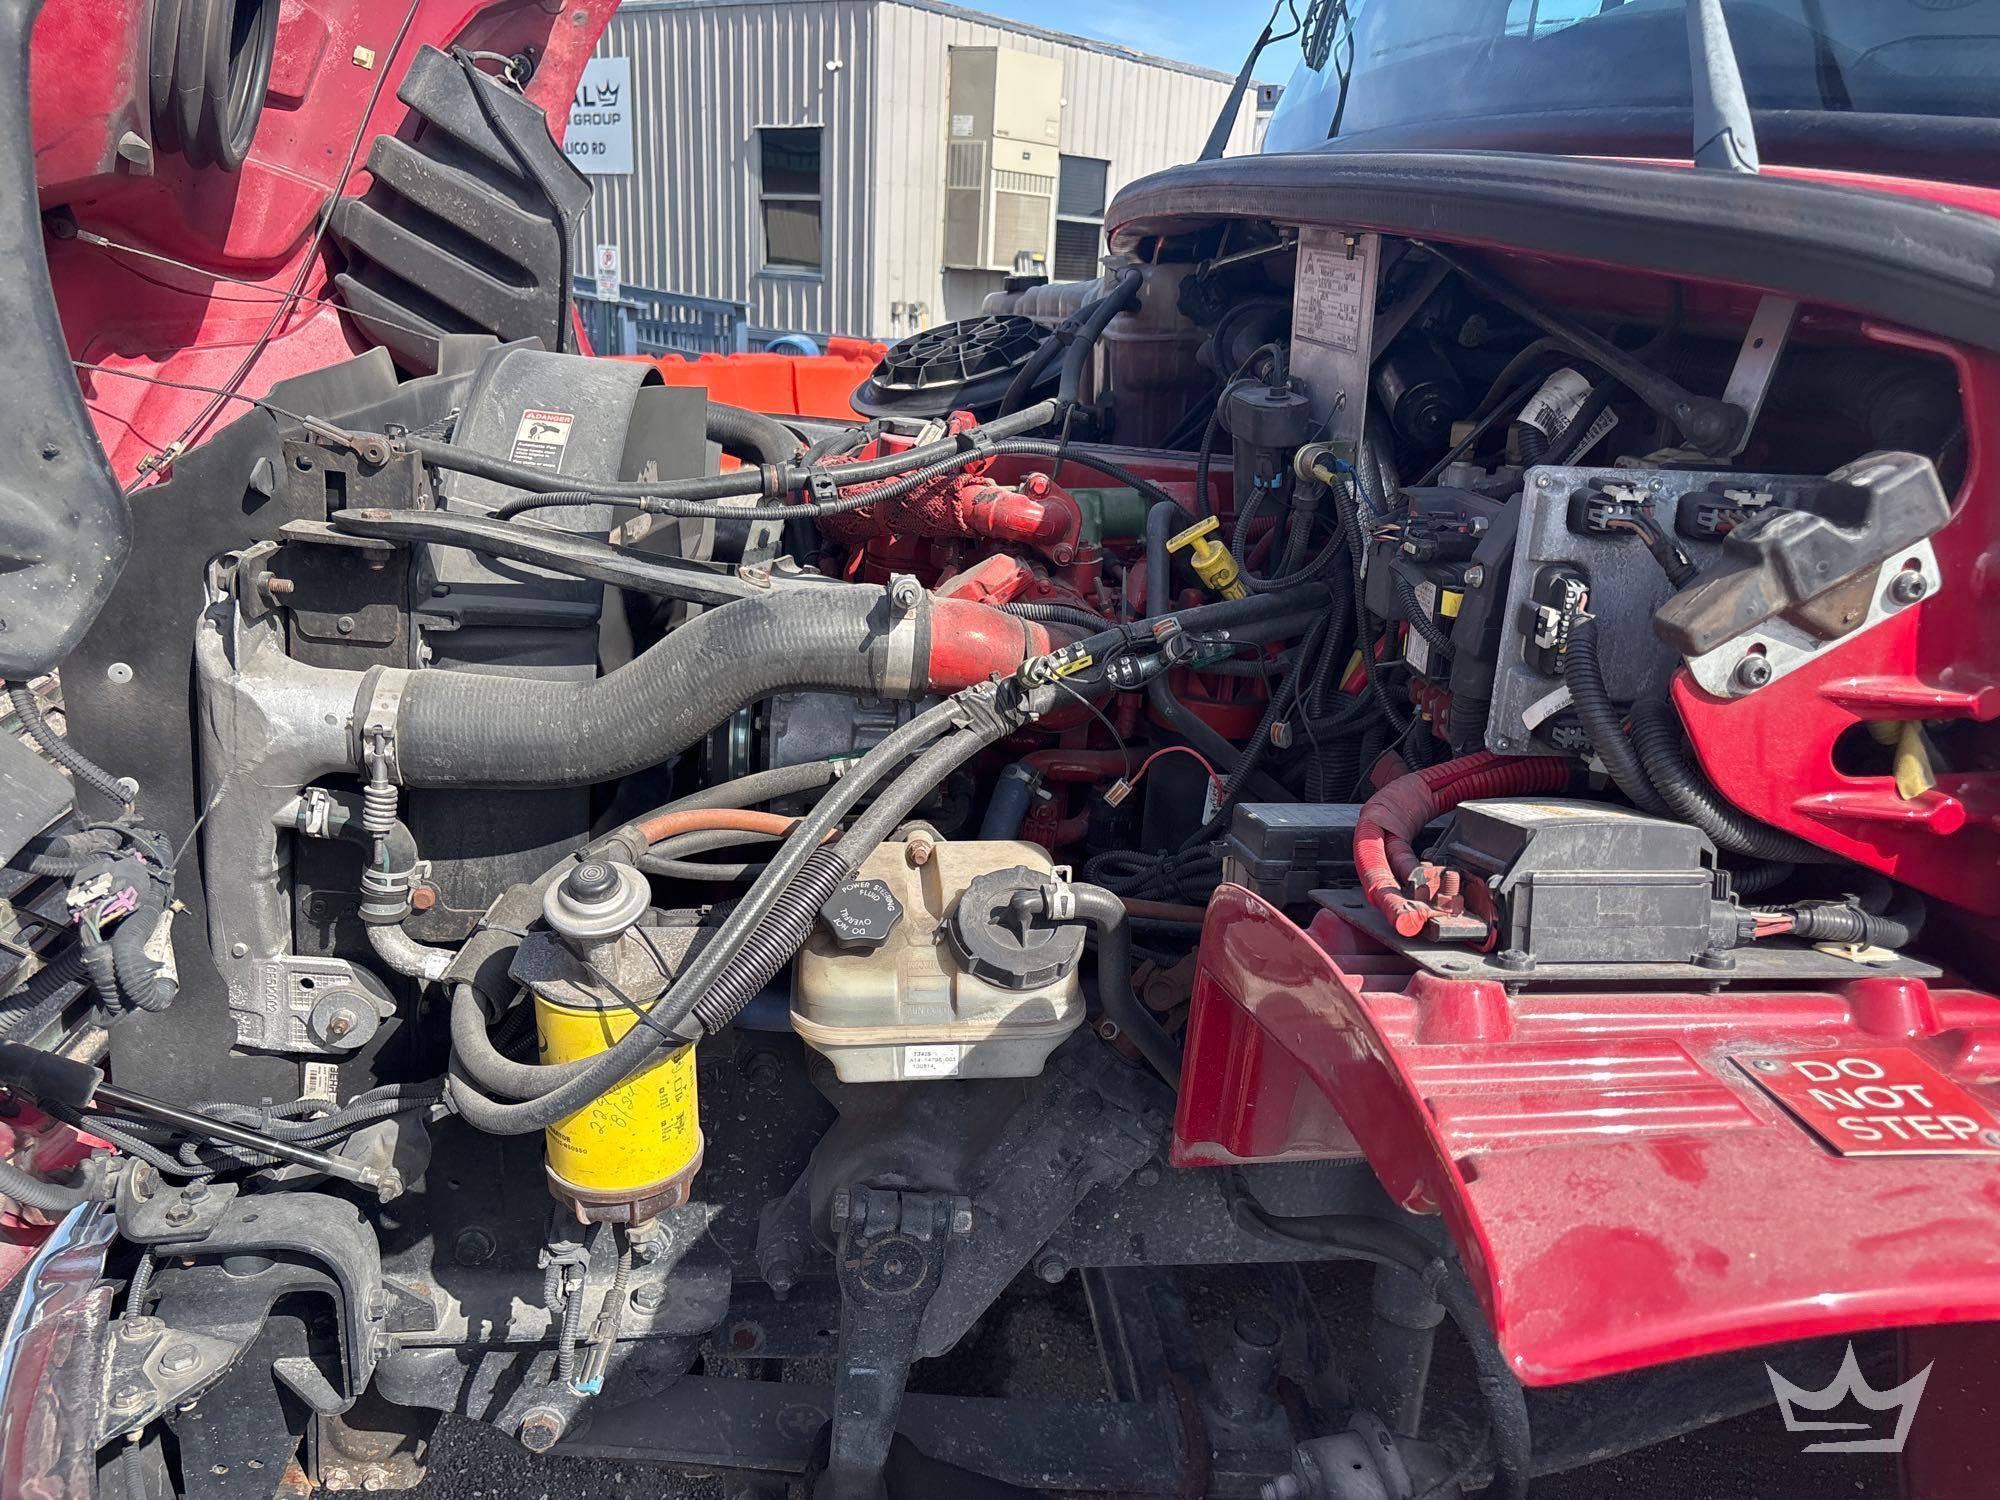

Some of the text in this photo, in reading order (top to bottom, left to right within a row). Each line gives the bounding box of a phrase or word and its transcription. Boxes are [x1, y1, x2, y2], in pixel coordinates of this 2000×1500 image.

[573, 113, 622, 126] GROUP
[592, 142, 607, 155] RD
[535, 413, 571, 423] DANGER
[841, 881, 896, 912] POWER STEERING
[859, 889, 881, 902] FLUID
[833, 917, 866, 935] DO NOT
[840, 908, 872, 926] OVERFILL
[1791, 1058, 1885, 1082] DO
[1806, 1085, 1934, 1111] NOT
[1836, 1115, 1980, 1141] STEP
